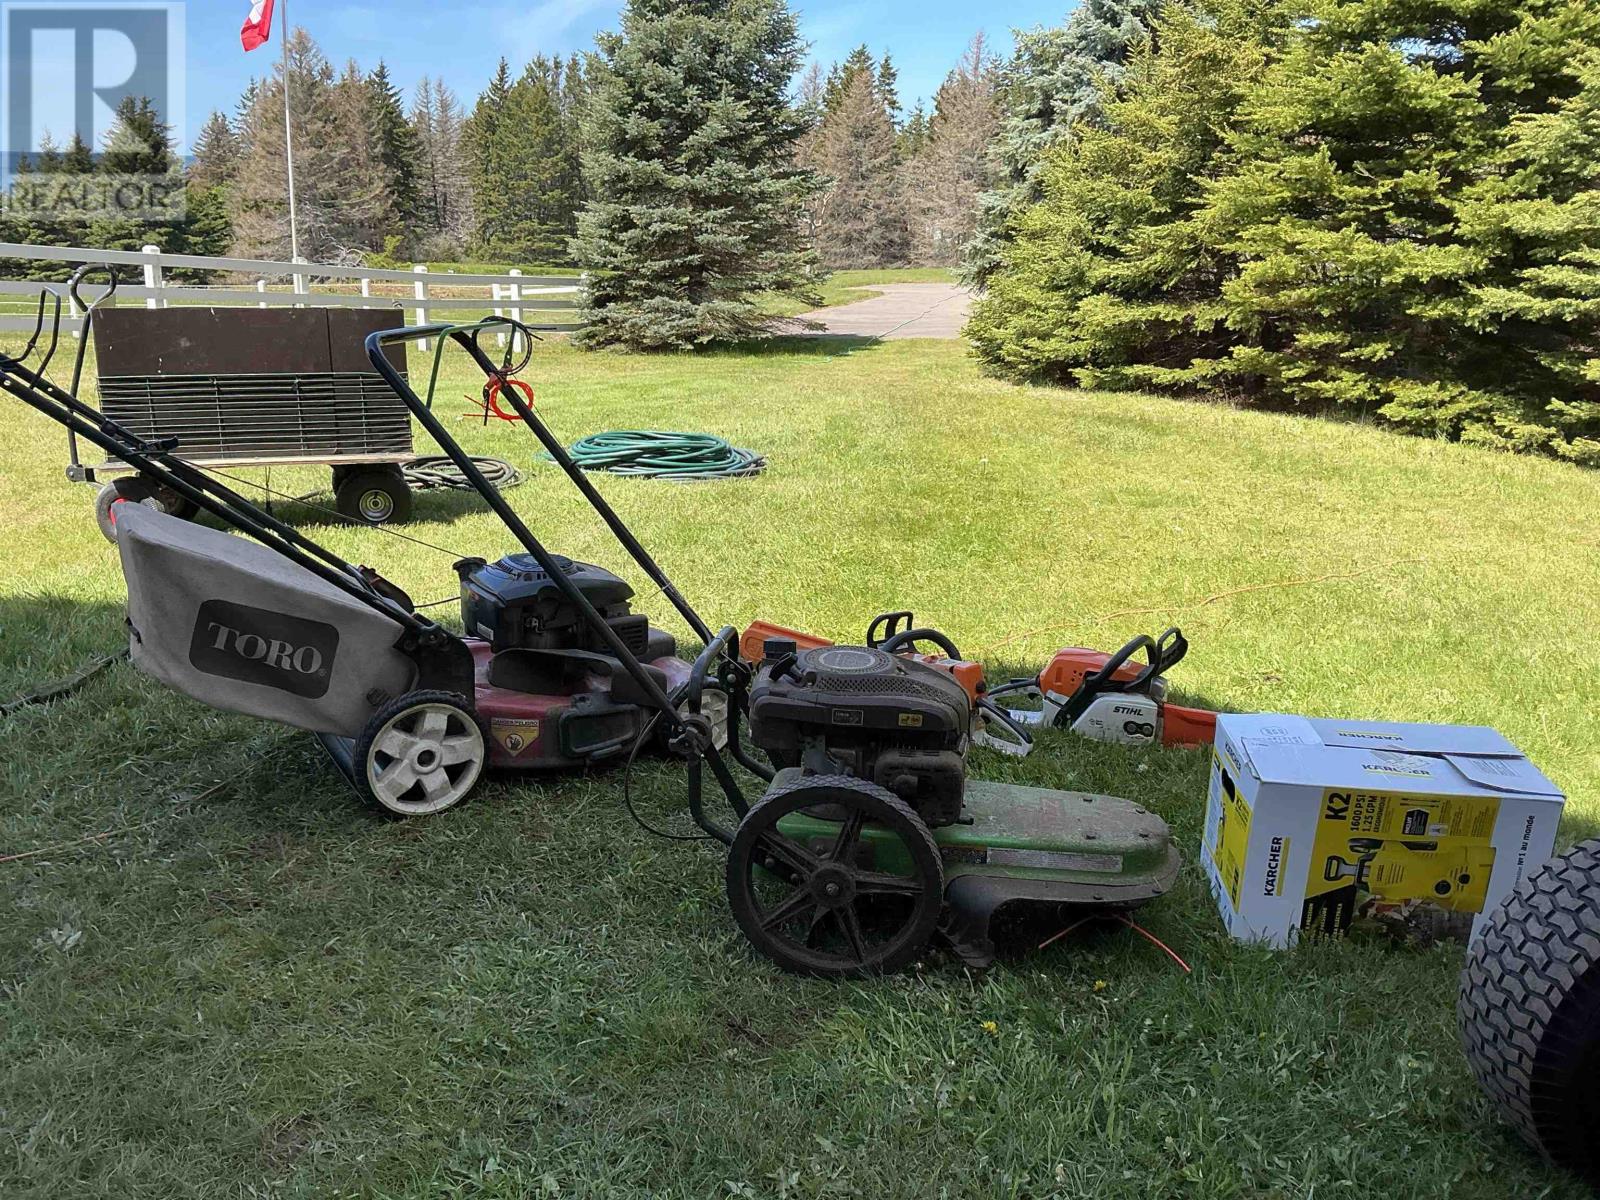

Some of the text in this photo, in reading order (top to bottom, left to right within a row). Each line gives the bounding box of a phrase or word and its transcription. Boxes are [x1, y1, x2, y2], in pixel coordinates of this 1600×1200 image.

[207, 621, 323, 674] TORO
[1113, 705, 1144, 716] STIHL
[1325, 792, 1351, 820] K2
[1350, 794, 1366, 832] 1600 PSI
[1362, 795, 1378, 832] 1.25 GPM
[1523, 815, 1535, 841] monde
[1520, 842, 1528, 851] au
[1263, 836, 1283, 897] KÄRCHER
